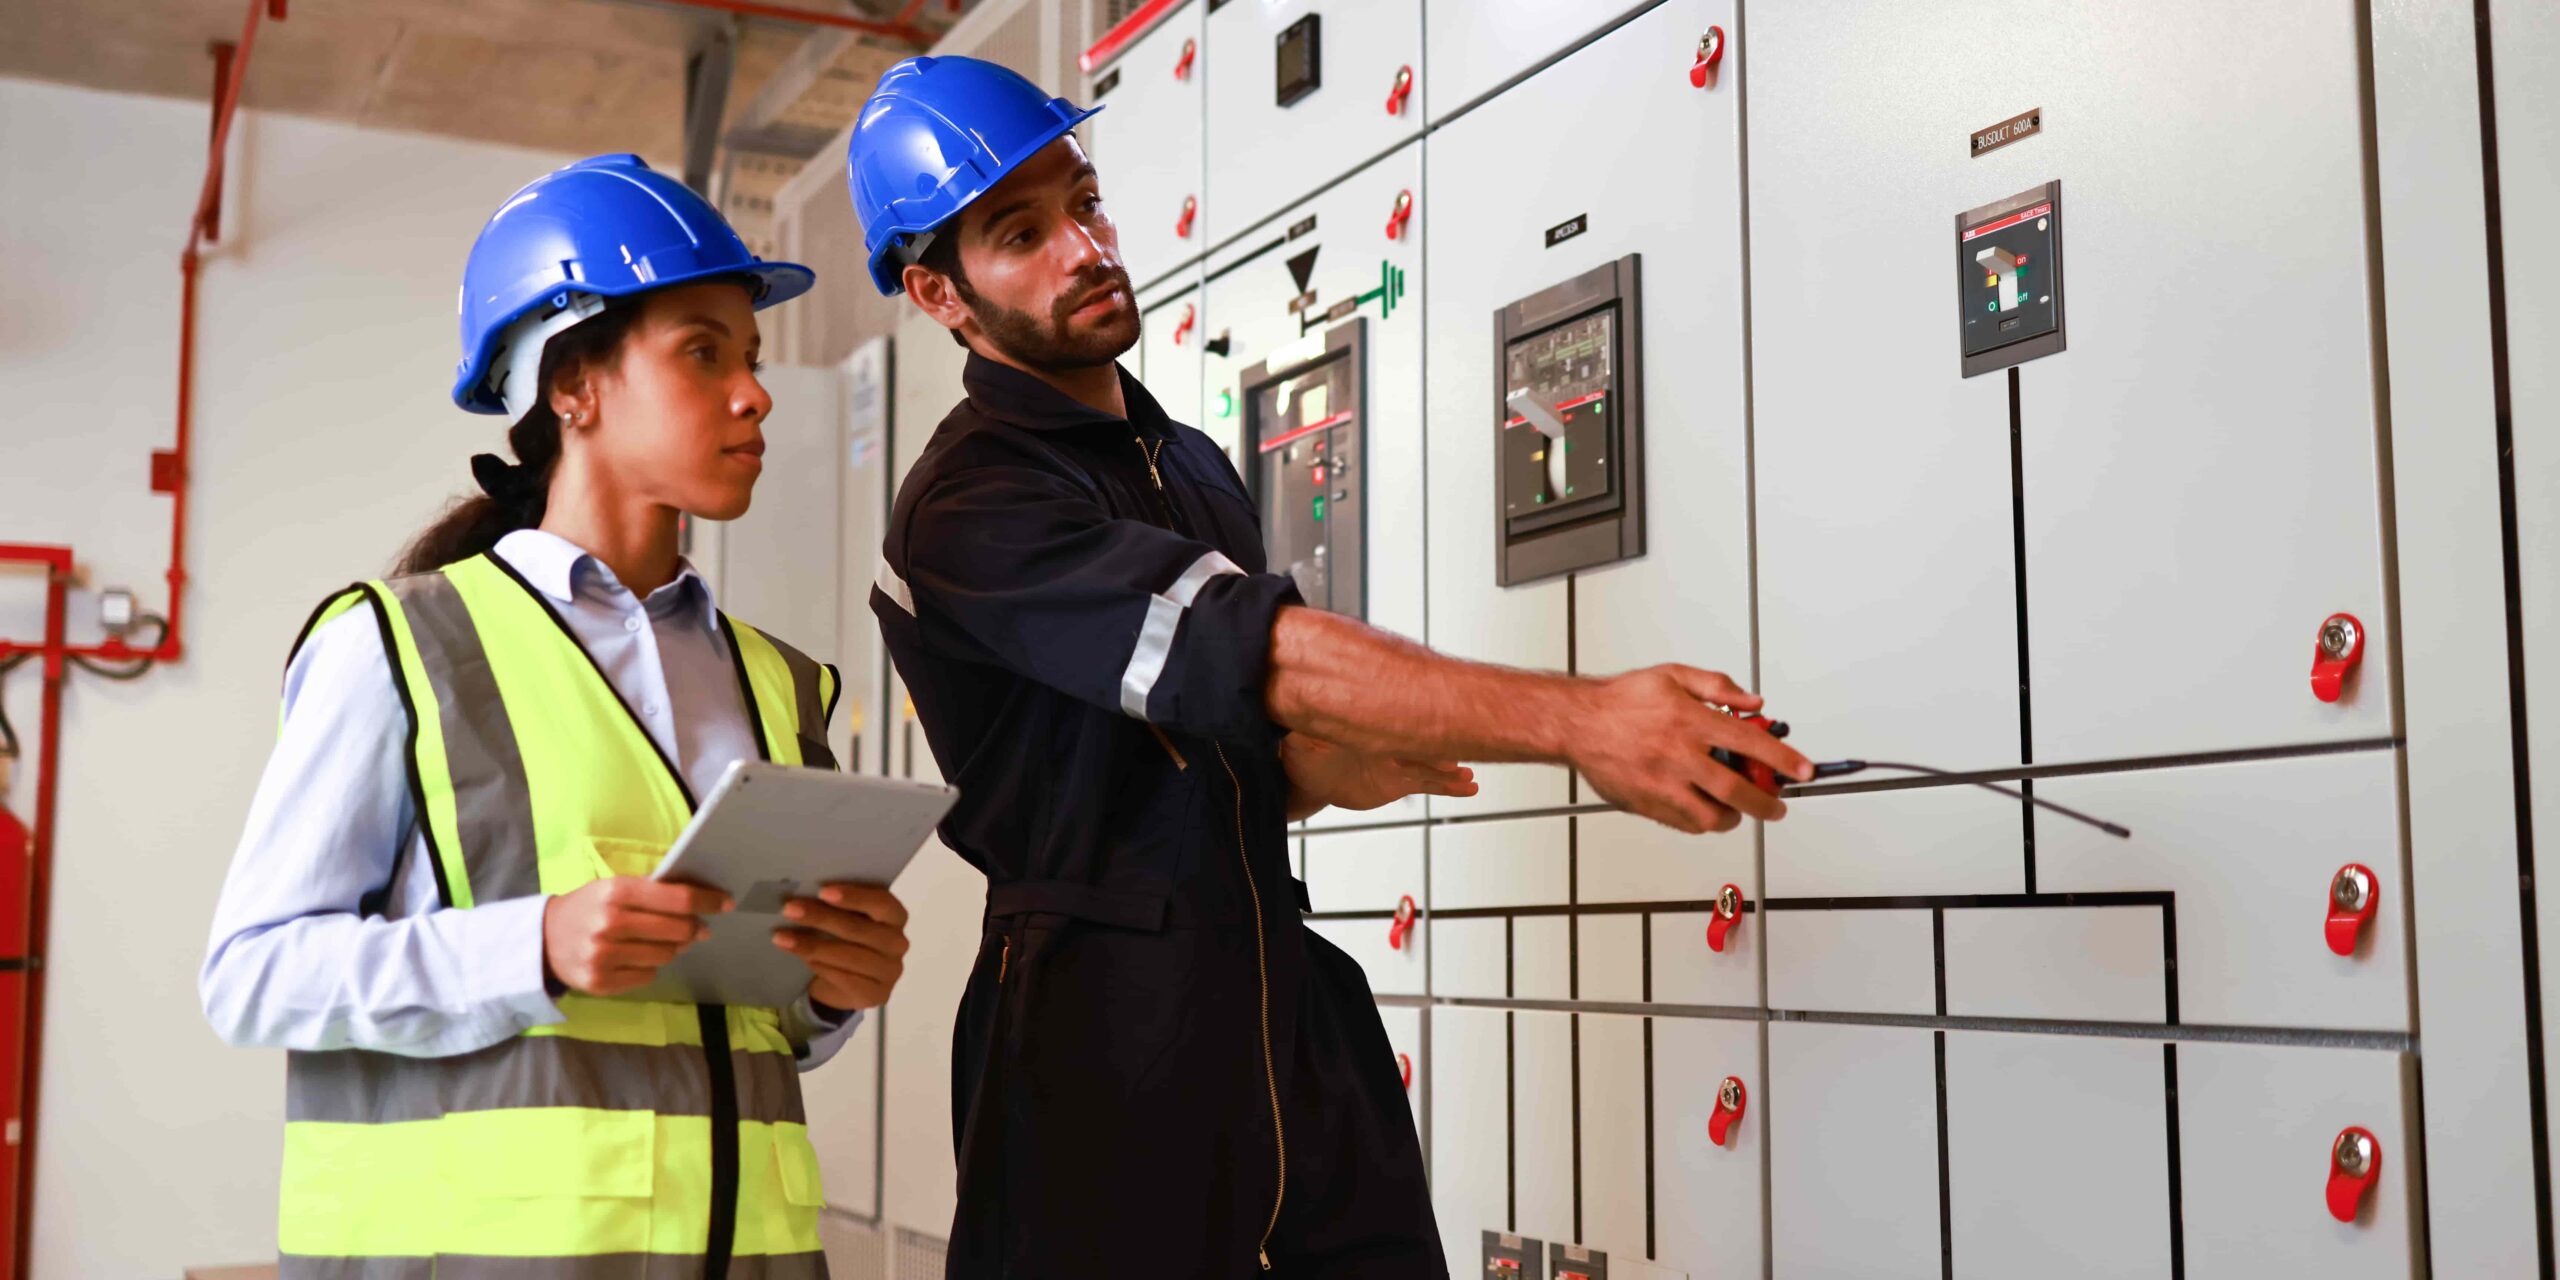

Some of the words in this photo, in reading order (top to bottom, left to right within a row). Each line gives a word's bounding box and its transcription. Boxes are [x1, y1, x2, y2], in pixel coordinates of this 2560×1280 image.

[1978, 125, 2010, 149] BUSDUCT
[2013, 117, 2032, 135] 600A
[2017, 256, 2027, 265] on
[2018, 292, 2028, 302] off
